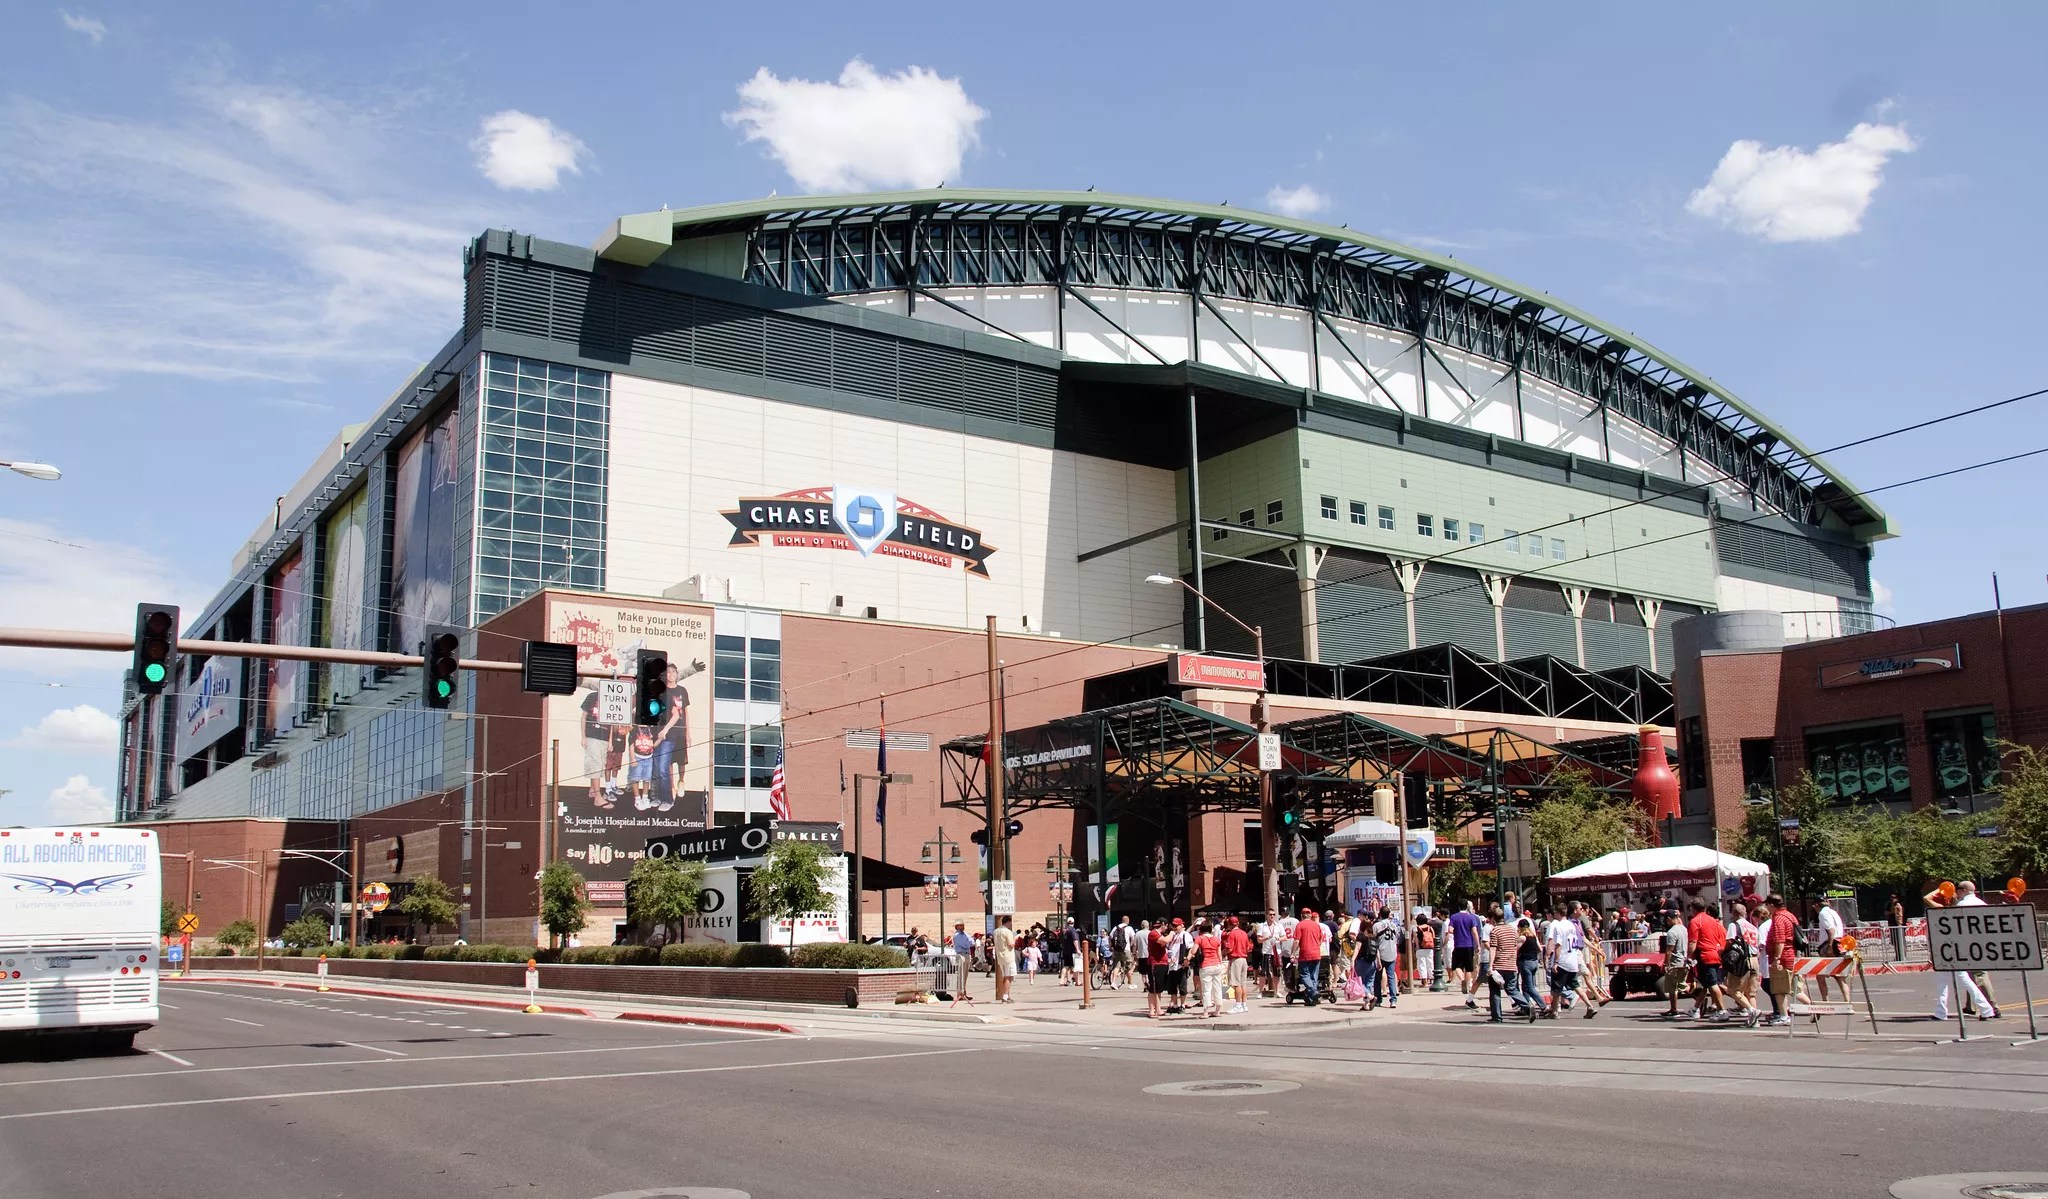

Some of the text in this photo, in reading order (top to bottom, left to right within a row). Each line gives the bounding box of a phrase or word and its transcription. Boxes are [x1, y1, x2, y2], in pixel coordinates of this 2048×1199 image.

[749, 506, 975, 551] CHASE FIELD
[779, 536, 806, 545] HOME
[813, 538, 825, 546] OF
[883, 545, 949, 565] DIAMONDBACKS
[617, 611, 702, 630] Make your pledge
[556, 626, 614, 649] No Chew
[617, 624, 707, 640] to be tobacco free!
[1201, 664, 1246, 680] DIAMONDBACKS
[1247, 670, 1260, 681] WAY
[607, 684, 624, 693] NO
[604, 695, 627, 703] TURN
[609, 704, 622, 712] ON
[606, 713, 624, 721] RED
[1265, 737, 1275, 745] NO
[1022, 752, 1051, 766] SOLAR
[1051, 744, 1092, 762] PAVILION
[564, 815, 705, 829] St. Joseph's Hospital and Medical Center
[70, 837, 83, 845] 545
[777, 831, 839, 842] OAKLEY
[4, 844, 147, 863] ALL ABOARD AMERICA!
[567, 848, 587, 860] Say
[588, 843, 613, 865] NO
[614, 850, 625, 859] to
[680, 838, 727, 856] OAKLEY
[1435, 847, 1455, 855] FIEL
[688, 916, 733, 929] OAKLEY
[1938, 914, 2025, 935] STREET
[1940, 941, 2030, 962] CLOSED
